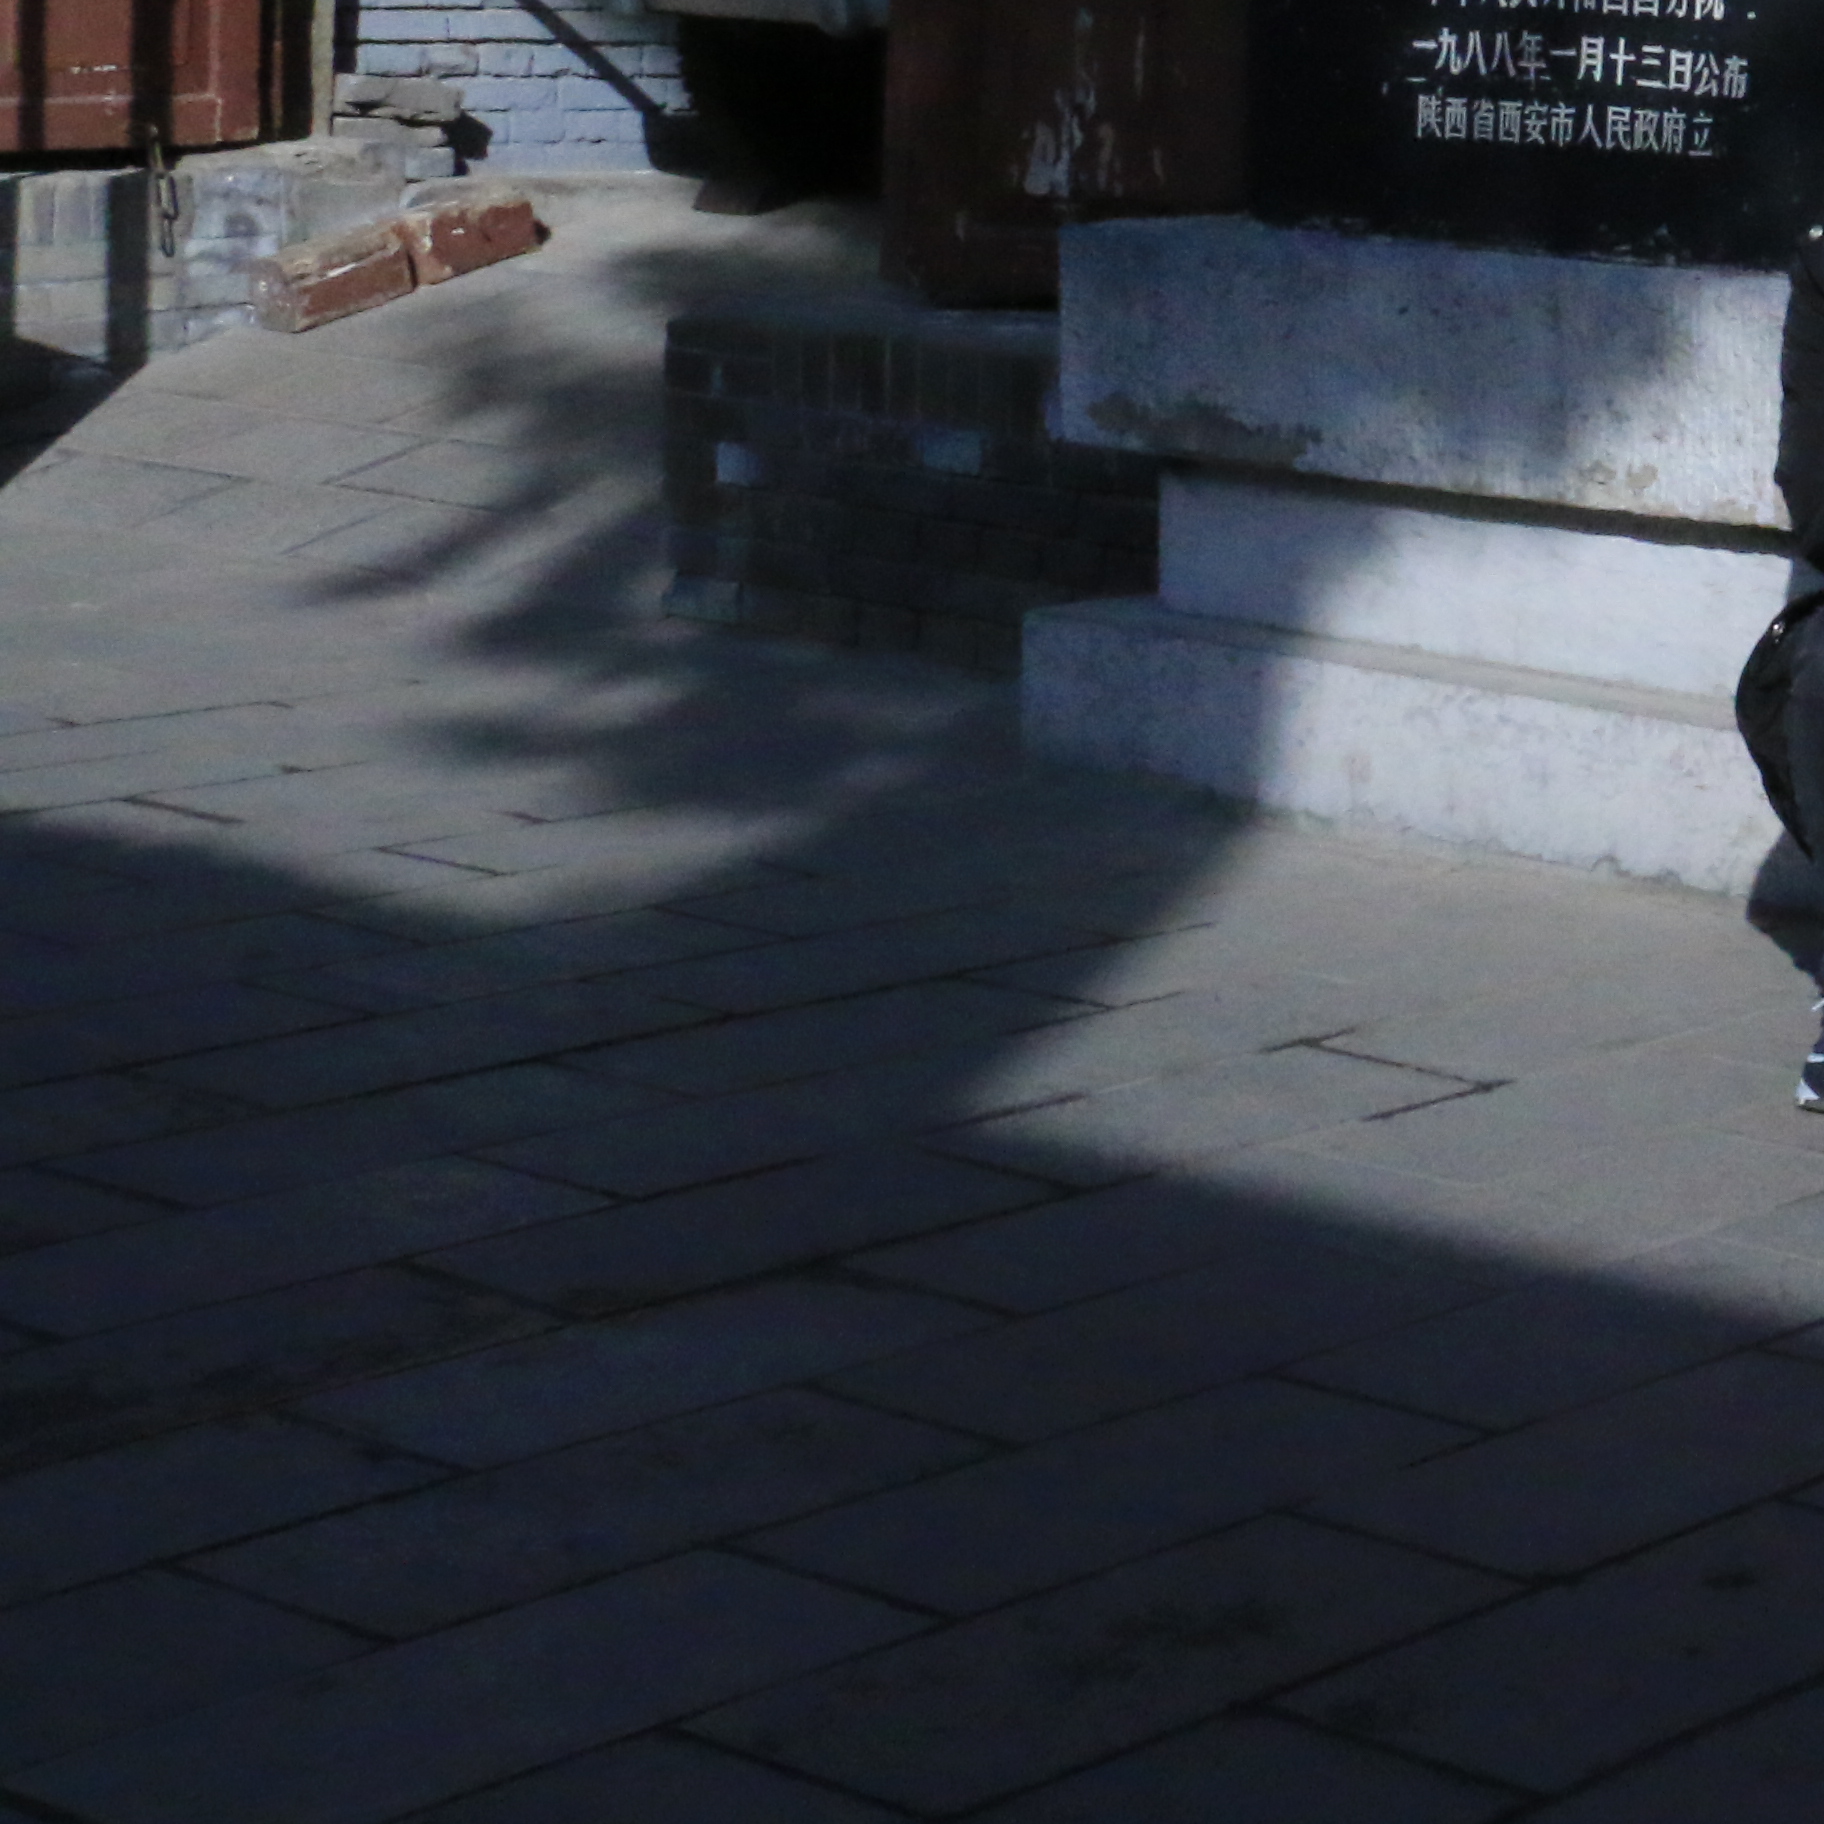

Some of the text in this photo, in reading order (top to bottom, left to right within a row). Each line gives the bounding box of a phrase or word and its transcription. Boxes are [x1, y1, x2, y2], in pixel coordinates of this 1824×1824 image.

[1411, 26, 1750, 102] 一九八八年一月十三日公布
[1415, 93, 1716, 159] 陕西省西安市人民政府立
